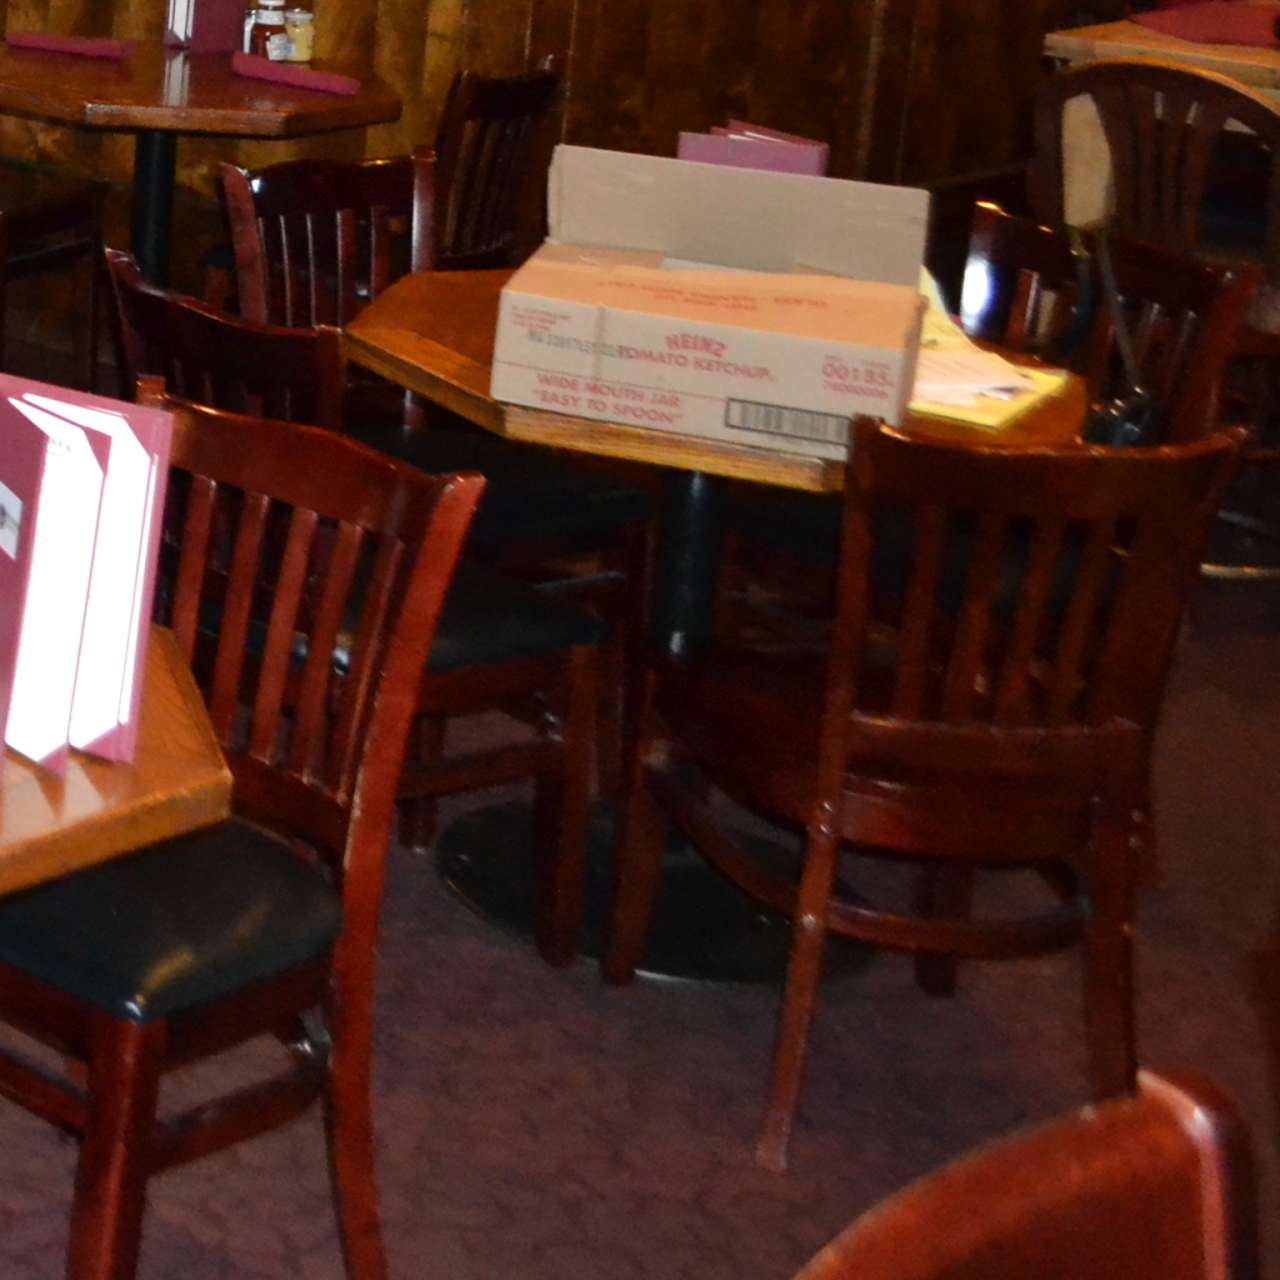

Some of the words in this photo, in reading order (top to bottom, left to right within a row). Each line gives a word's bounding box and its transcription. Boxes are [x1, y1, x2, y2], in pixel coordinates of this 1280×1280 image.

[617, 344, 689, 368] TOMATO
[665, 333, 728, 358] HEINZ
[537, 372, 578, 391] WIDE
[585, 383, 645, 402] MOUTH
[587, 398, 608, 413] TO
